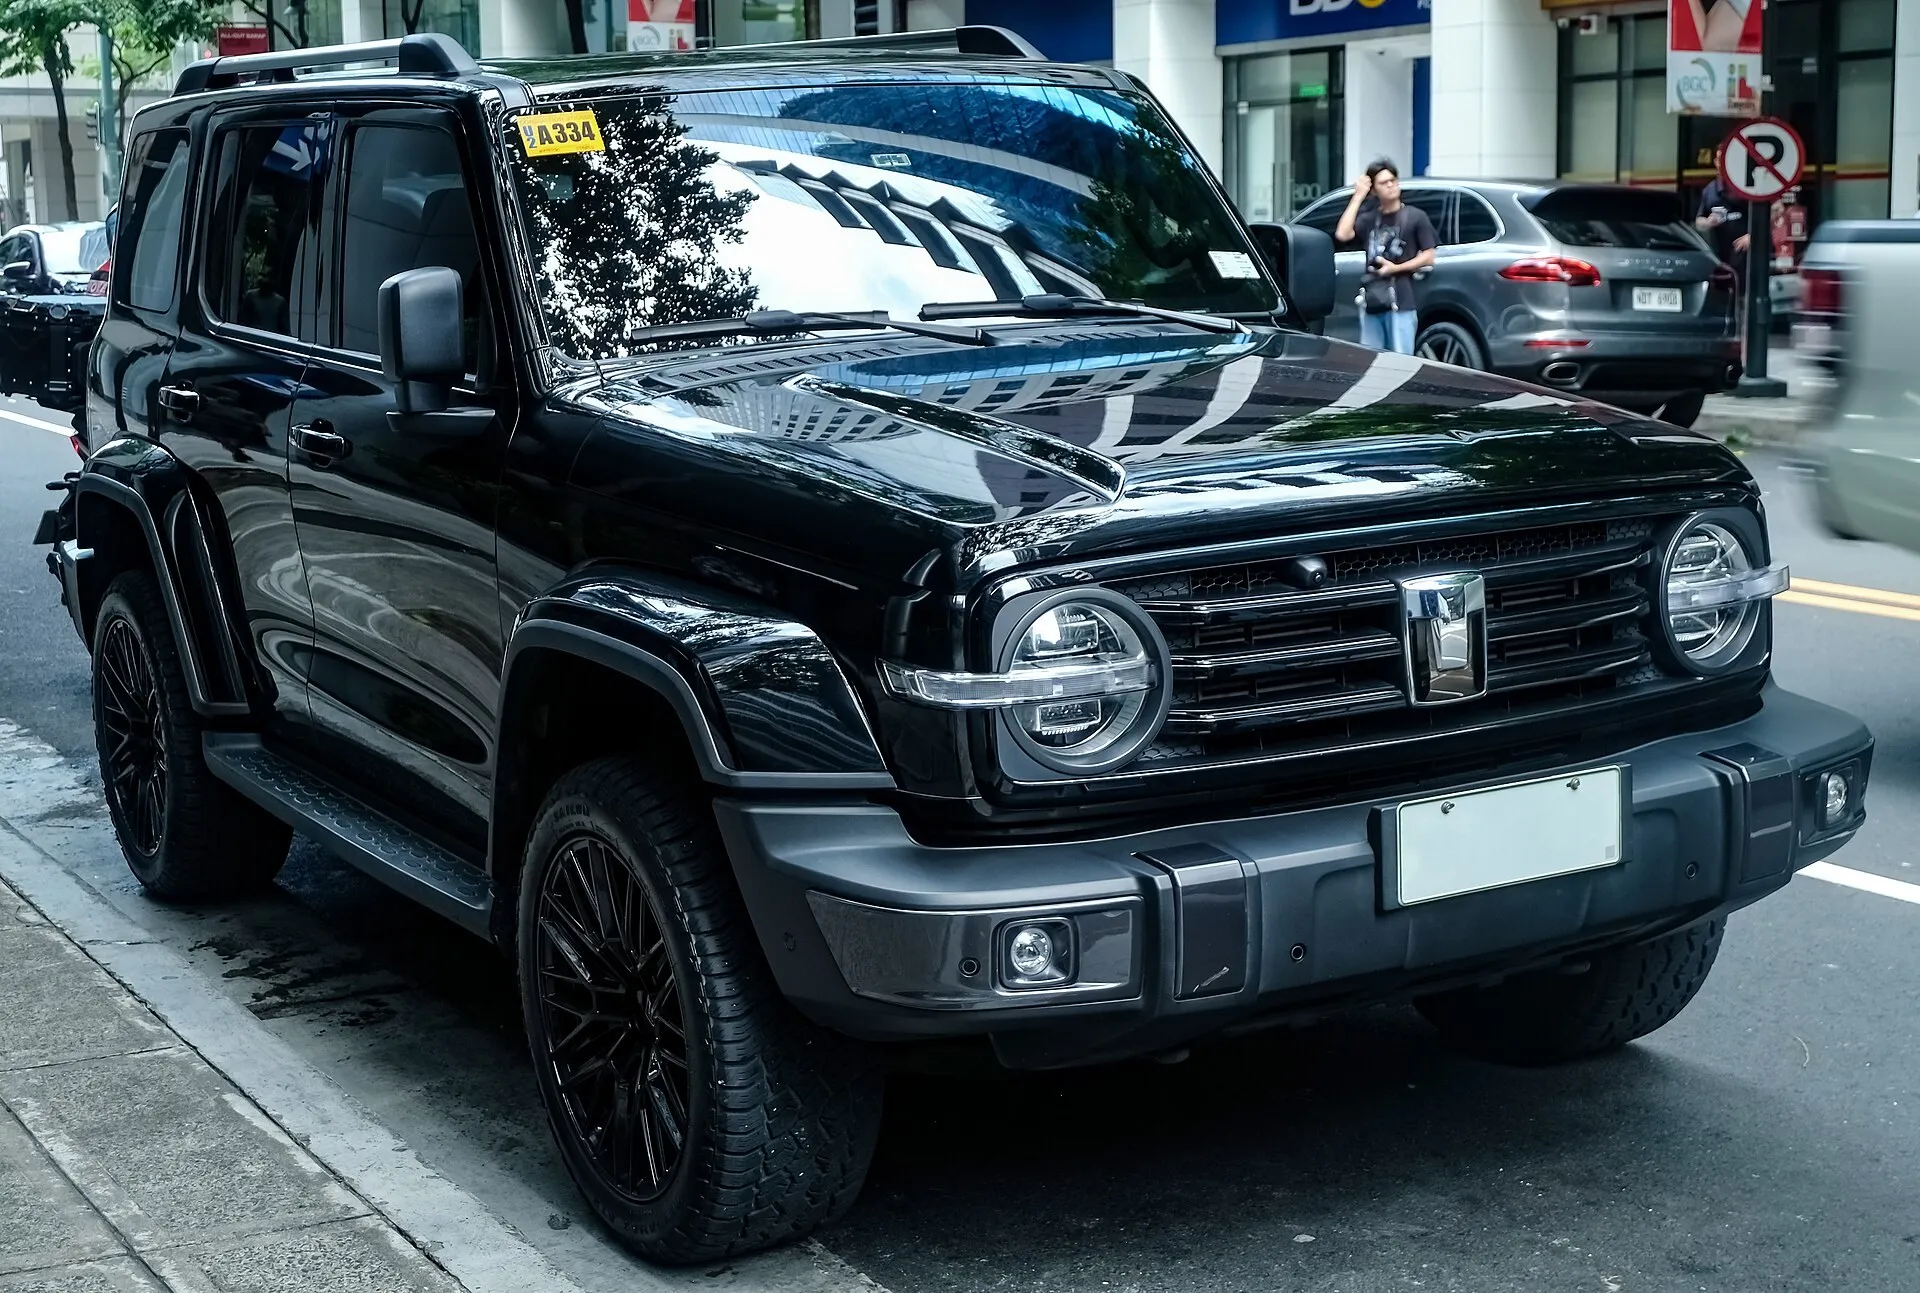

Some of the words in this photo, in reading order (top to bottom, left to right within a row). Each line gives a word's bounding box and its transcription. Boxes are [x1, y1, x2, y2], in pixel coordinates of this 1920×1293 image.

[1682, 75, 1708, 93] BGC
[537, 121, 595, 145] A334
[1745, 135, 1784, 187] P
